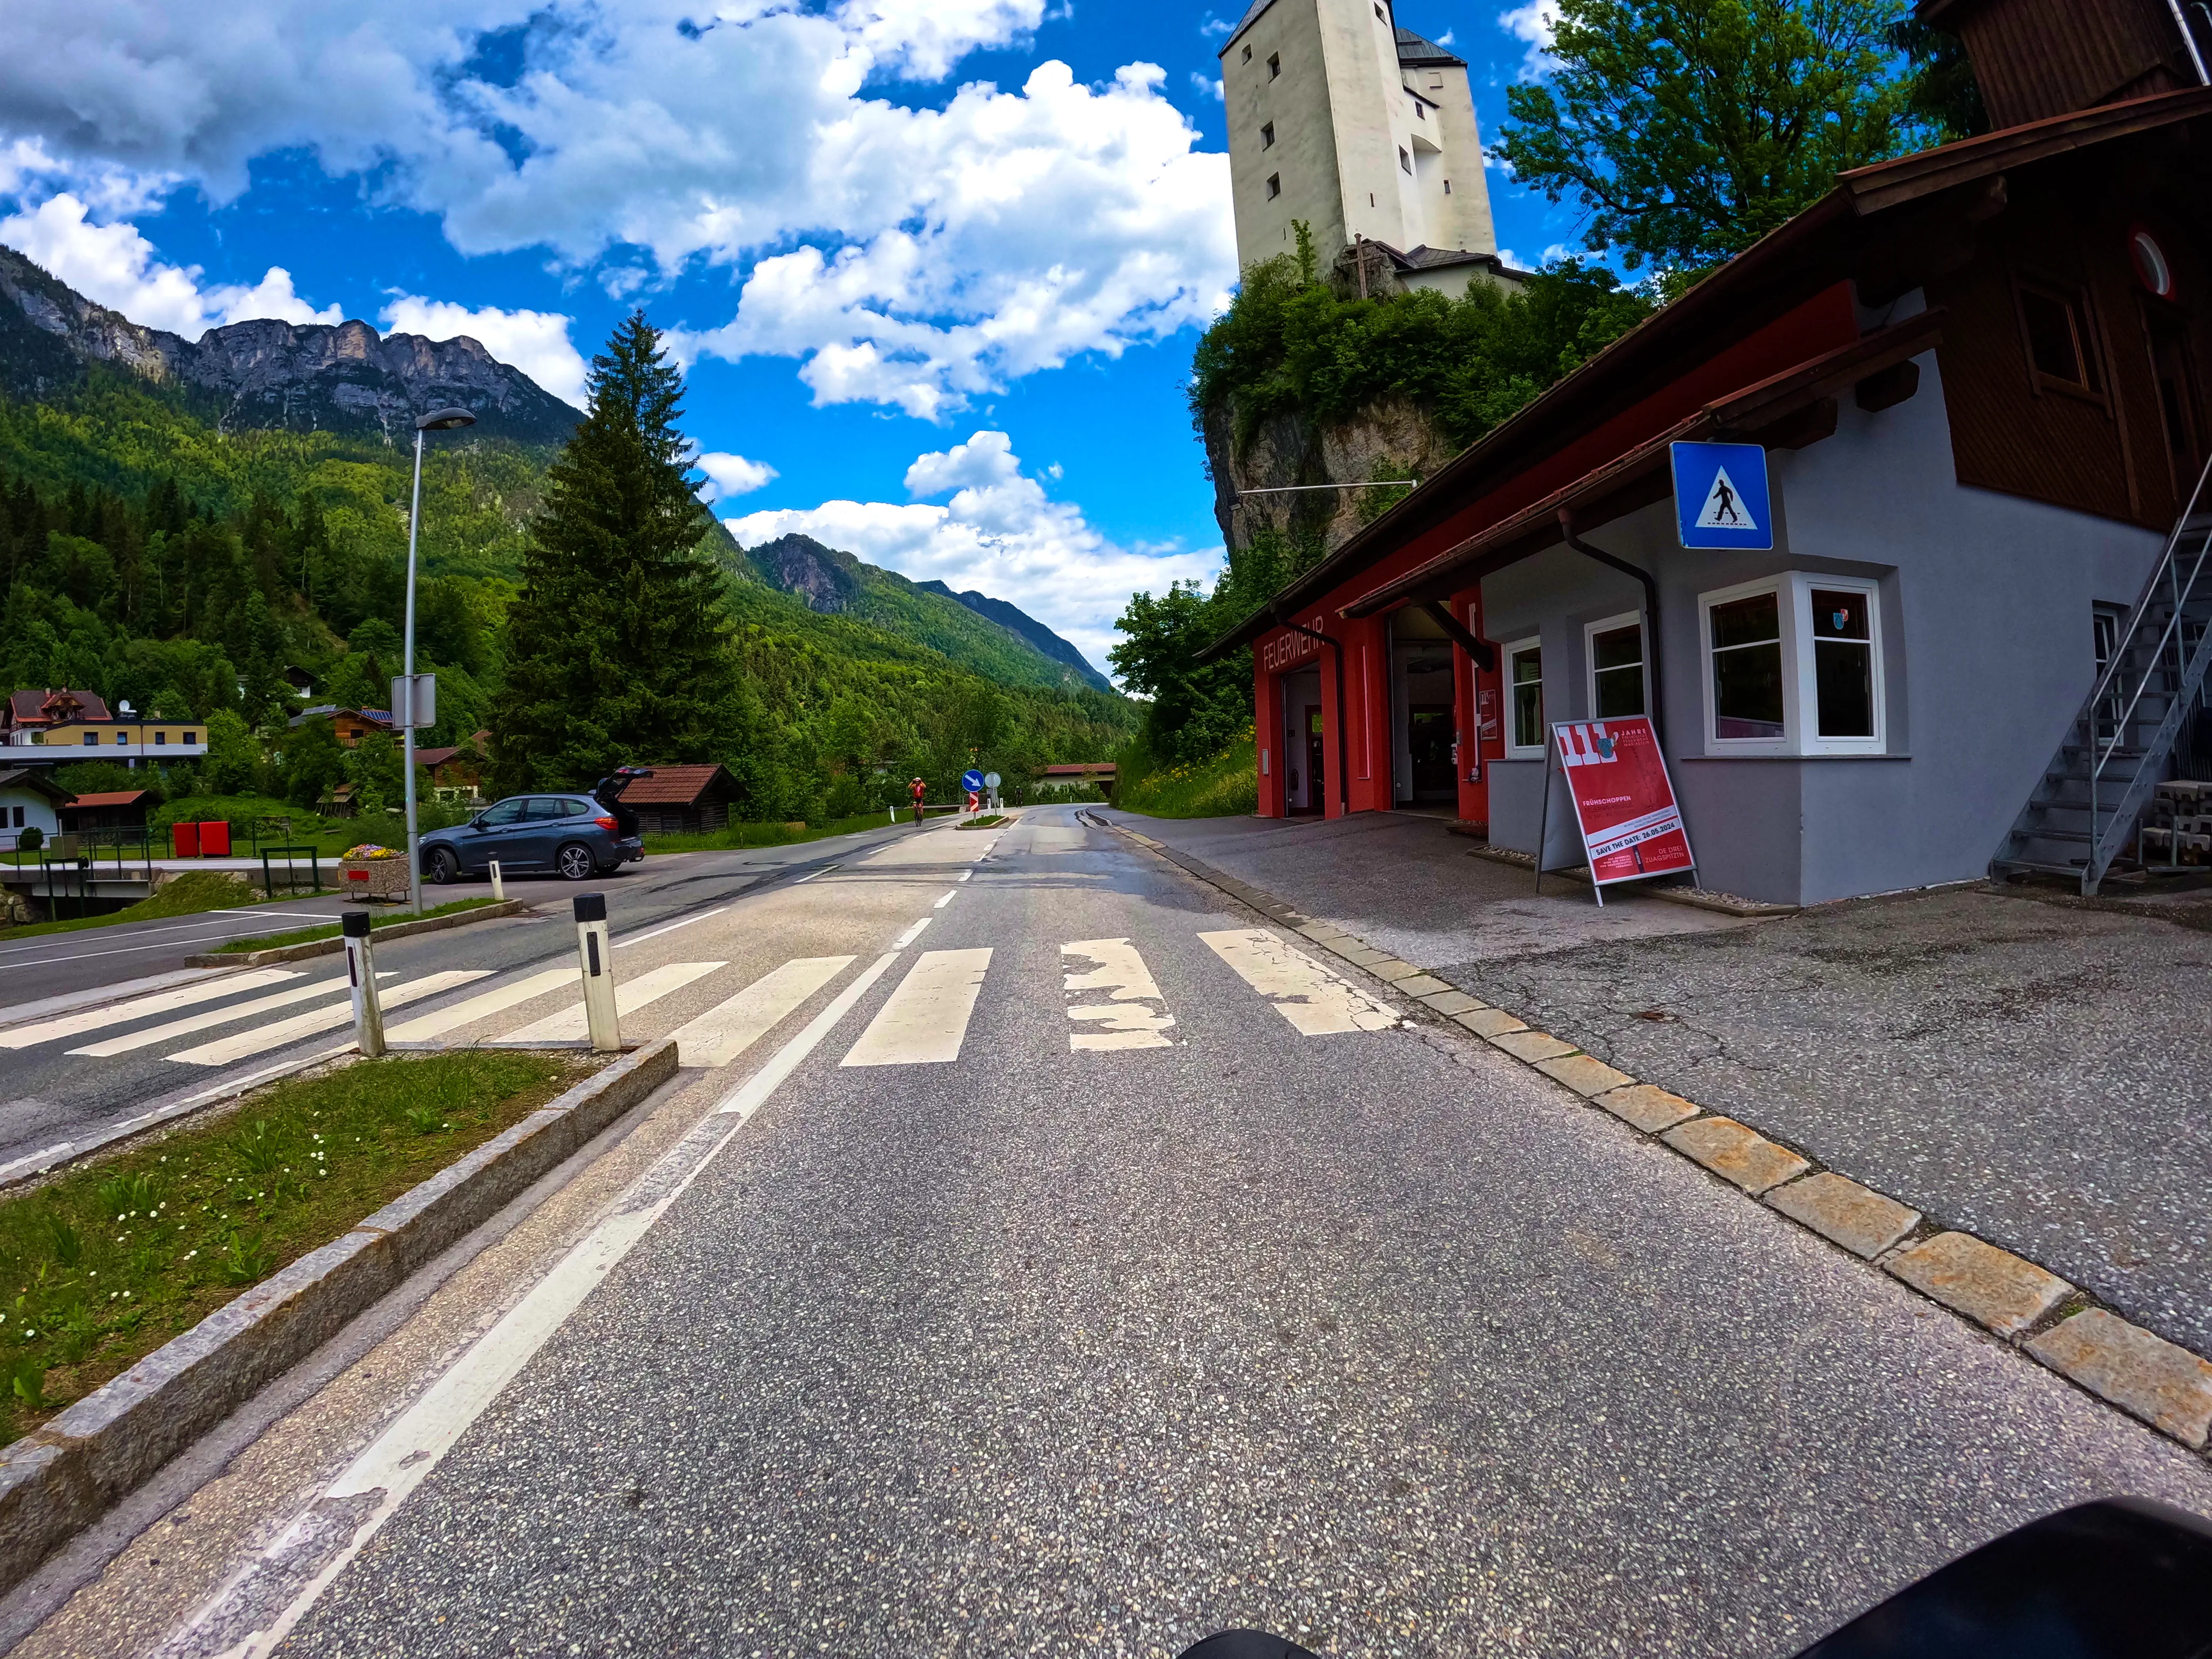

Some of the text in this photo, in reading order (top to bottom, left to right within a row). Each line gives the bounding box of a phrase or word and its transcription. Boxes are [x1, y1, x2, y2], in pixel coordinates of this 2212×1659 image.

[1264, 616, 1325, 672] FEUERWEHR
[1621, 728, 1647, 736] JAHRE
[1583, 795, 1631, 806] FRÜHSCHOPPEN
[1596, 822, 1675, 855] SAVE THE DATE: 26.05.2024
[1668, 845, 1682, 853] DREI
